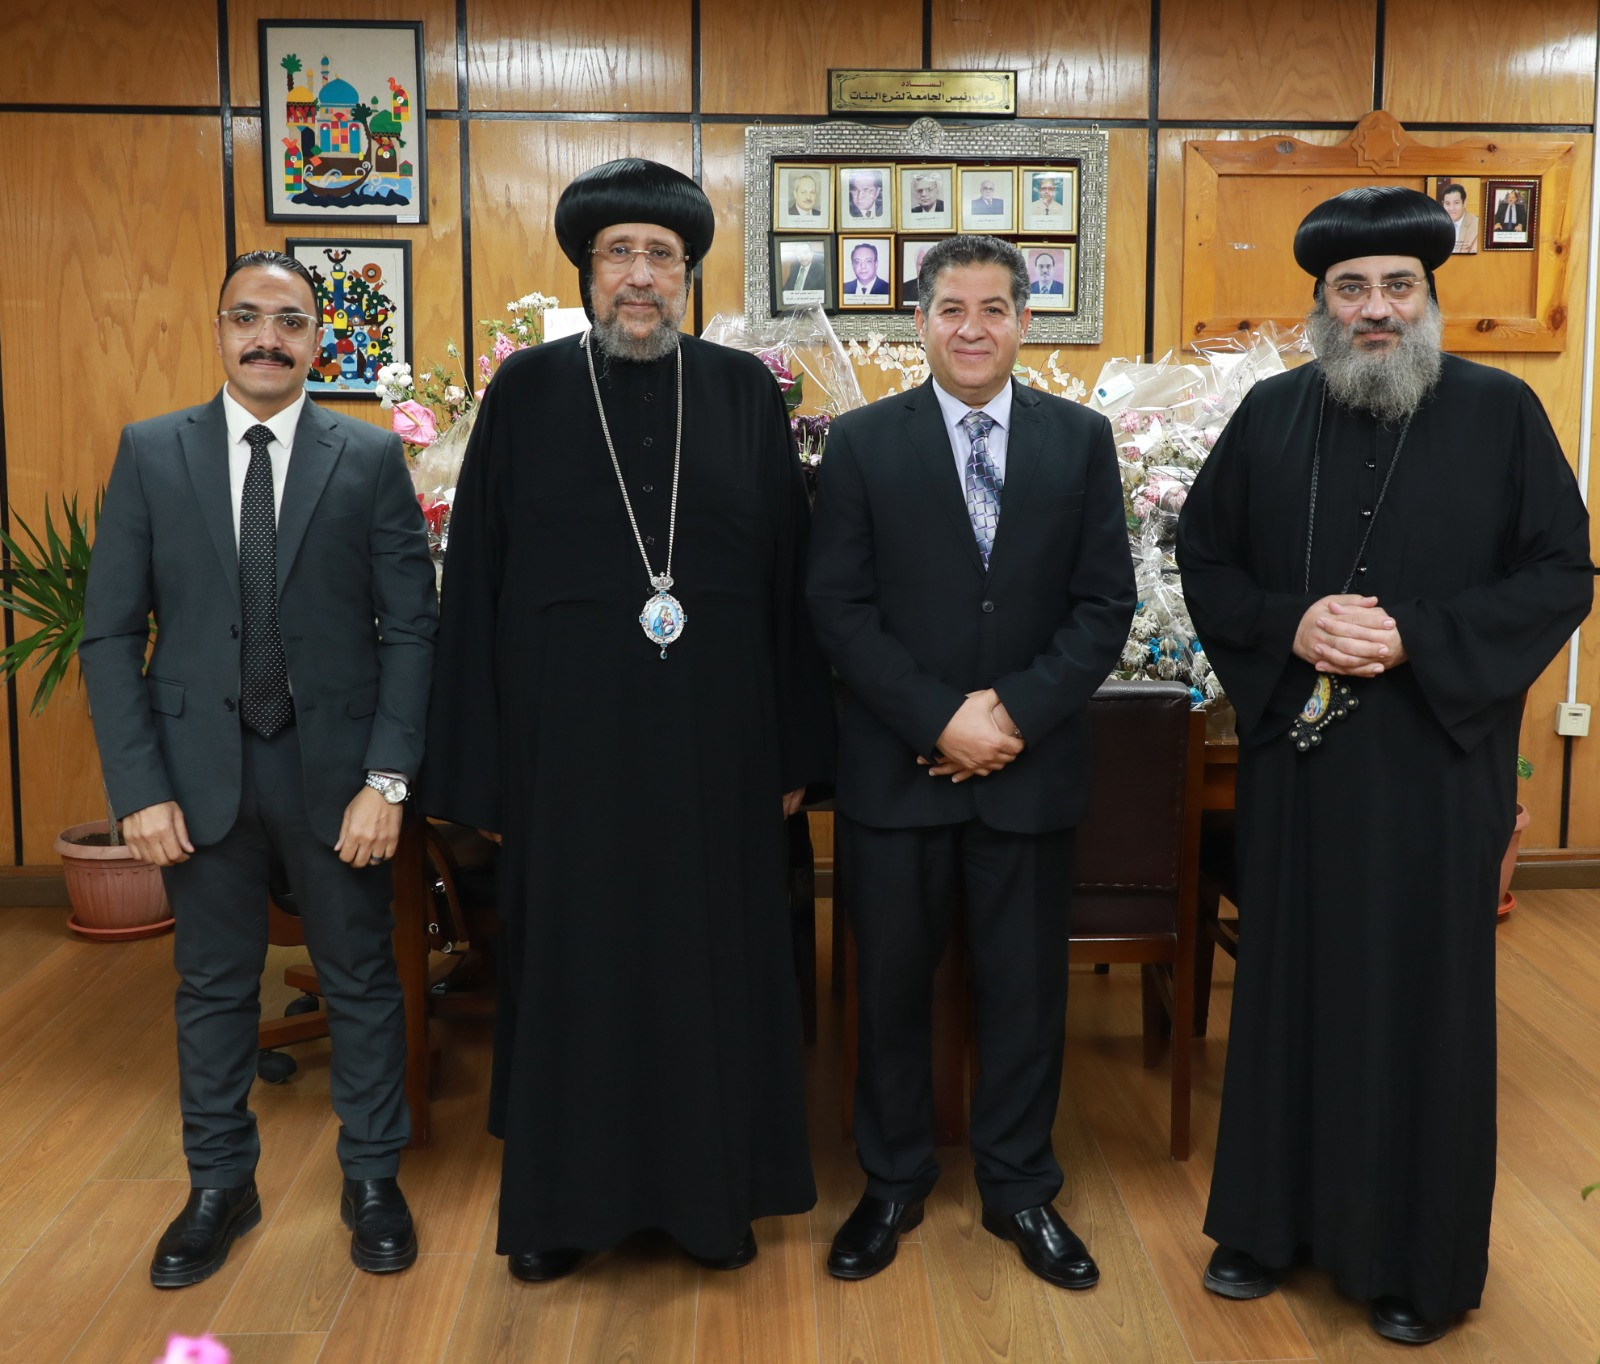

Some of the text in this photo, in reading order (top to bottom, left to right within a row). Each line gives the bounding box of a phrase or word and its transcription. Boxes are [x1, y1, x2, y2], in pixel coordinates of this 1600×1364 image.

[850, 91, 881, 103] البنات
[881, 91, 905, 103] لفرع
[906, 91, 944, 103] الجامعة
[945, 92, 972, 103] رئيس
